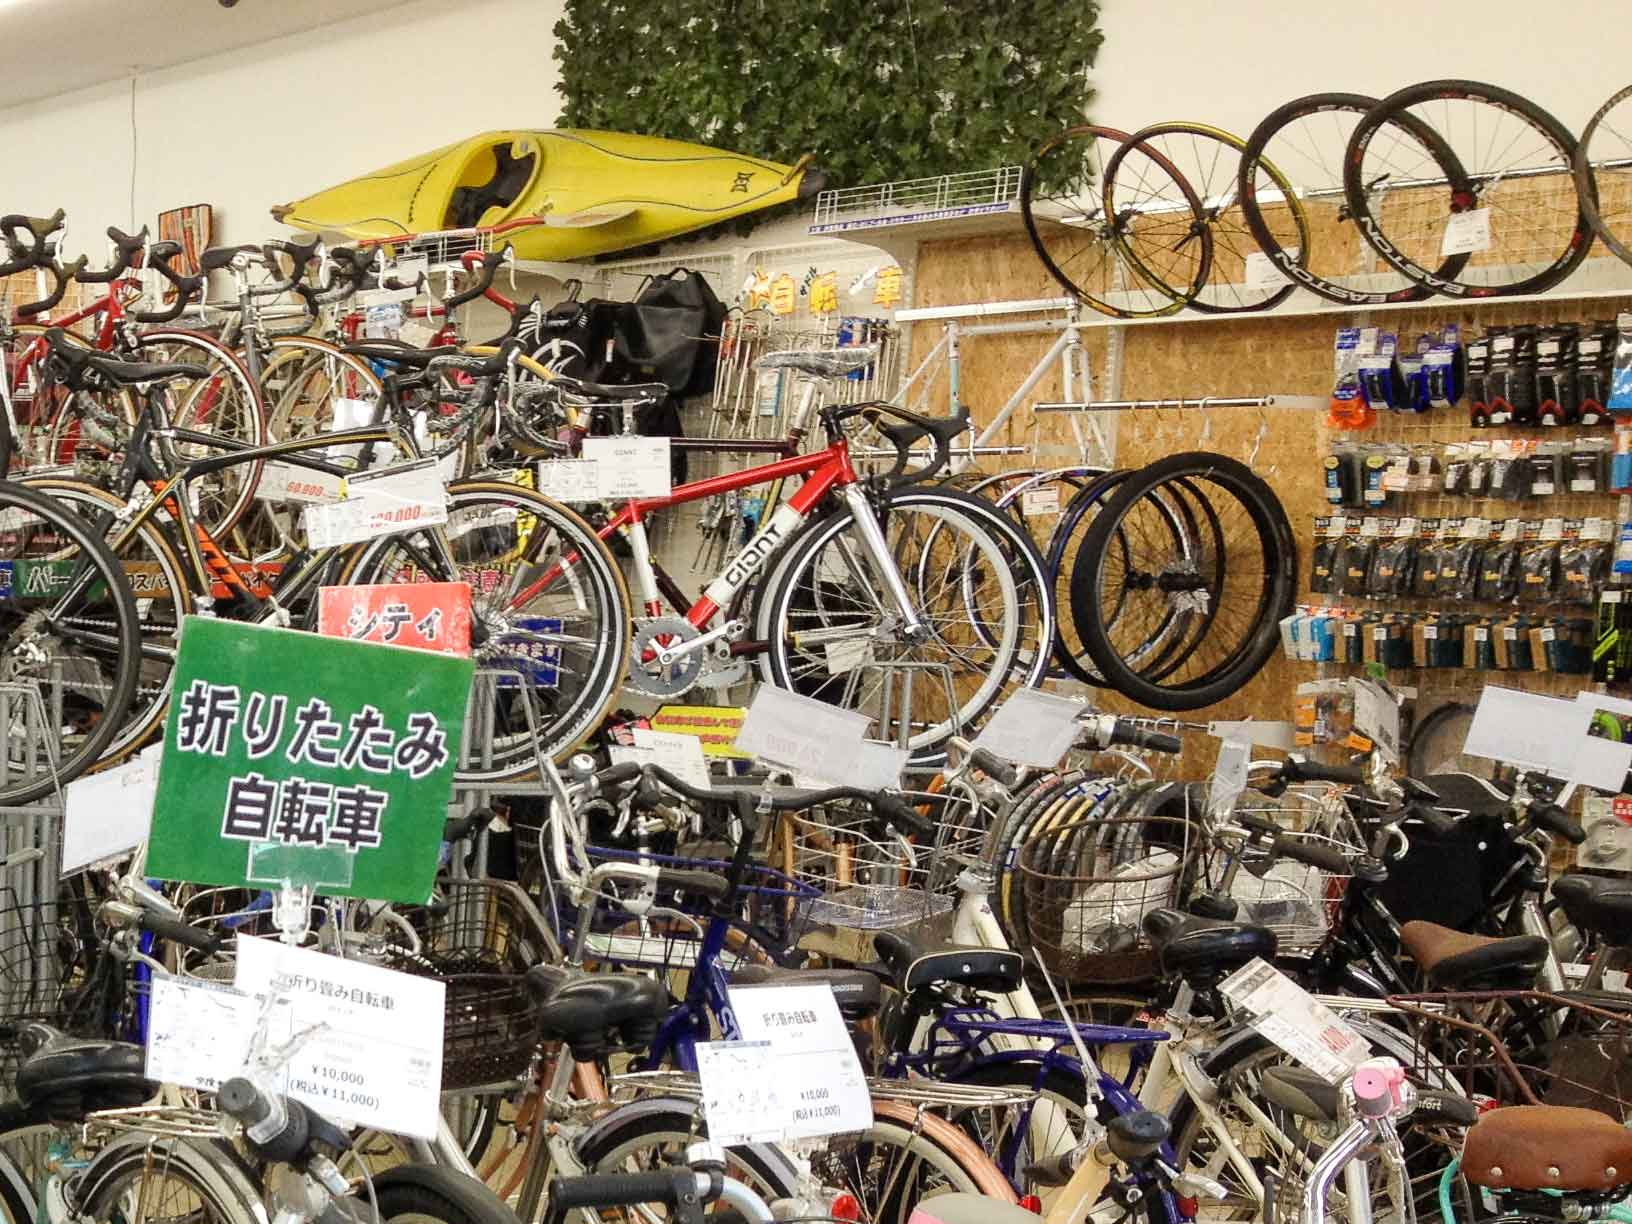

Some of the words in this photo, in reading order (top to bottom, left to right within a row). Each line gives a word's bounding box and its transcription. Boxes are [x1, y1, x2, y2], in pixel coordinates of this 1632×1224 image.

[725, 523, 782, 588] GIANT
[347, 603, 443, 642] シティ
[177, 680, 449, 780] 折りたたみ
[220, 772, 389, 853] 自転車
